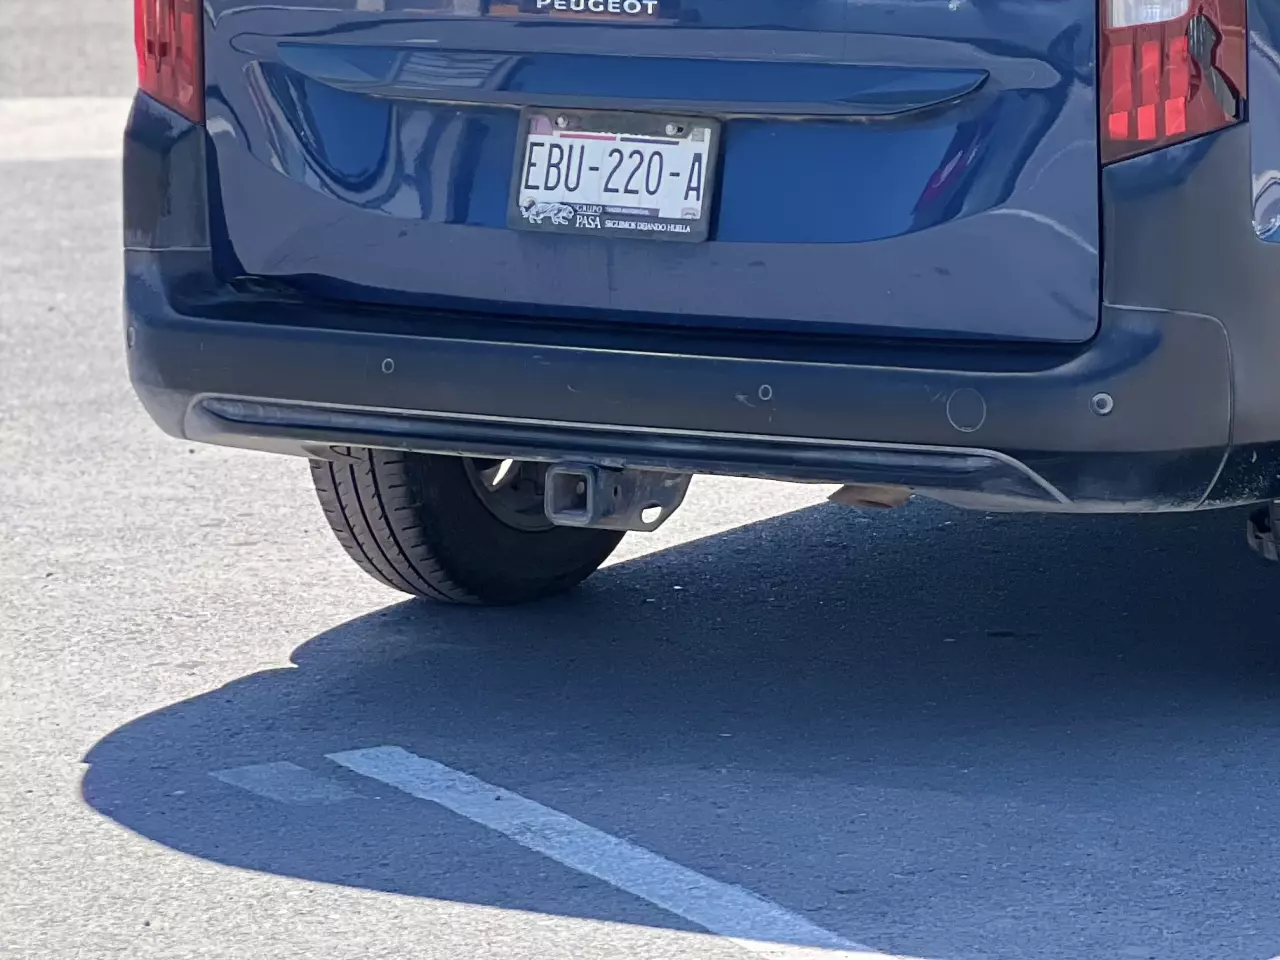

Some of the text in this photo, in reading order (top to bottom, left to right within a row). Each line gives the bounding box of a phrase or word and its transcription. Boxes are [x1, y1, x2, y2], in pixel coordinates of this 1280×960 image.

[523, 141, 704, 202] EBU-220-A
[576, 204, 603, 214] GRUPO
[575, 215, 602, 230] PASA
